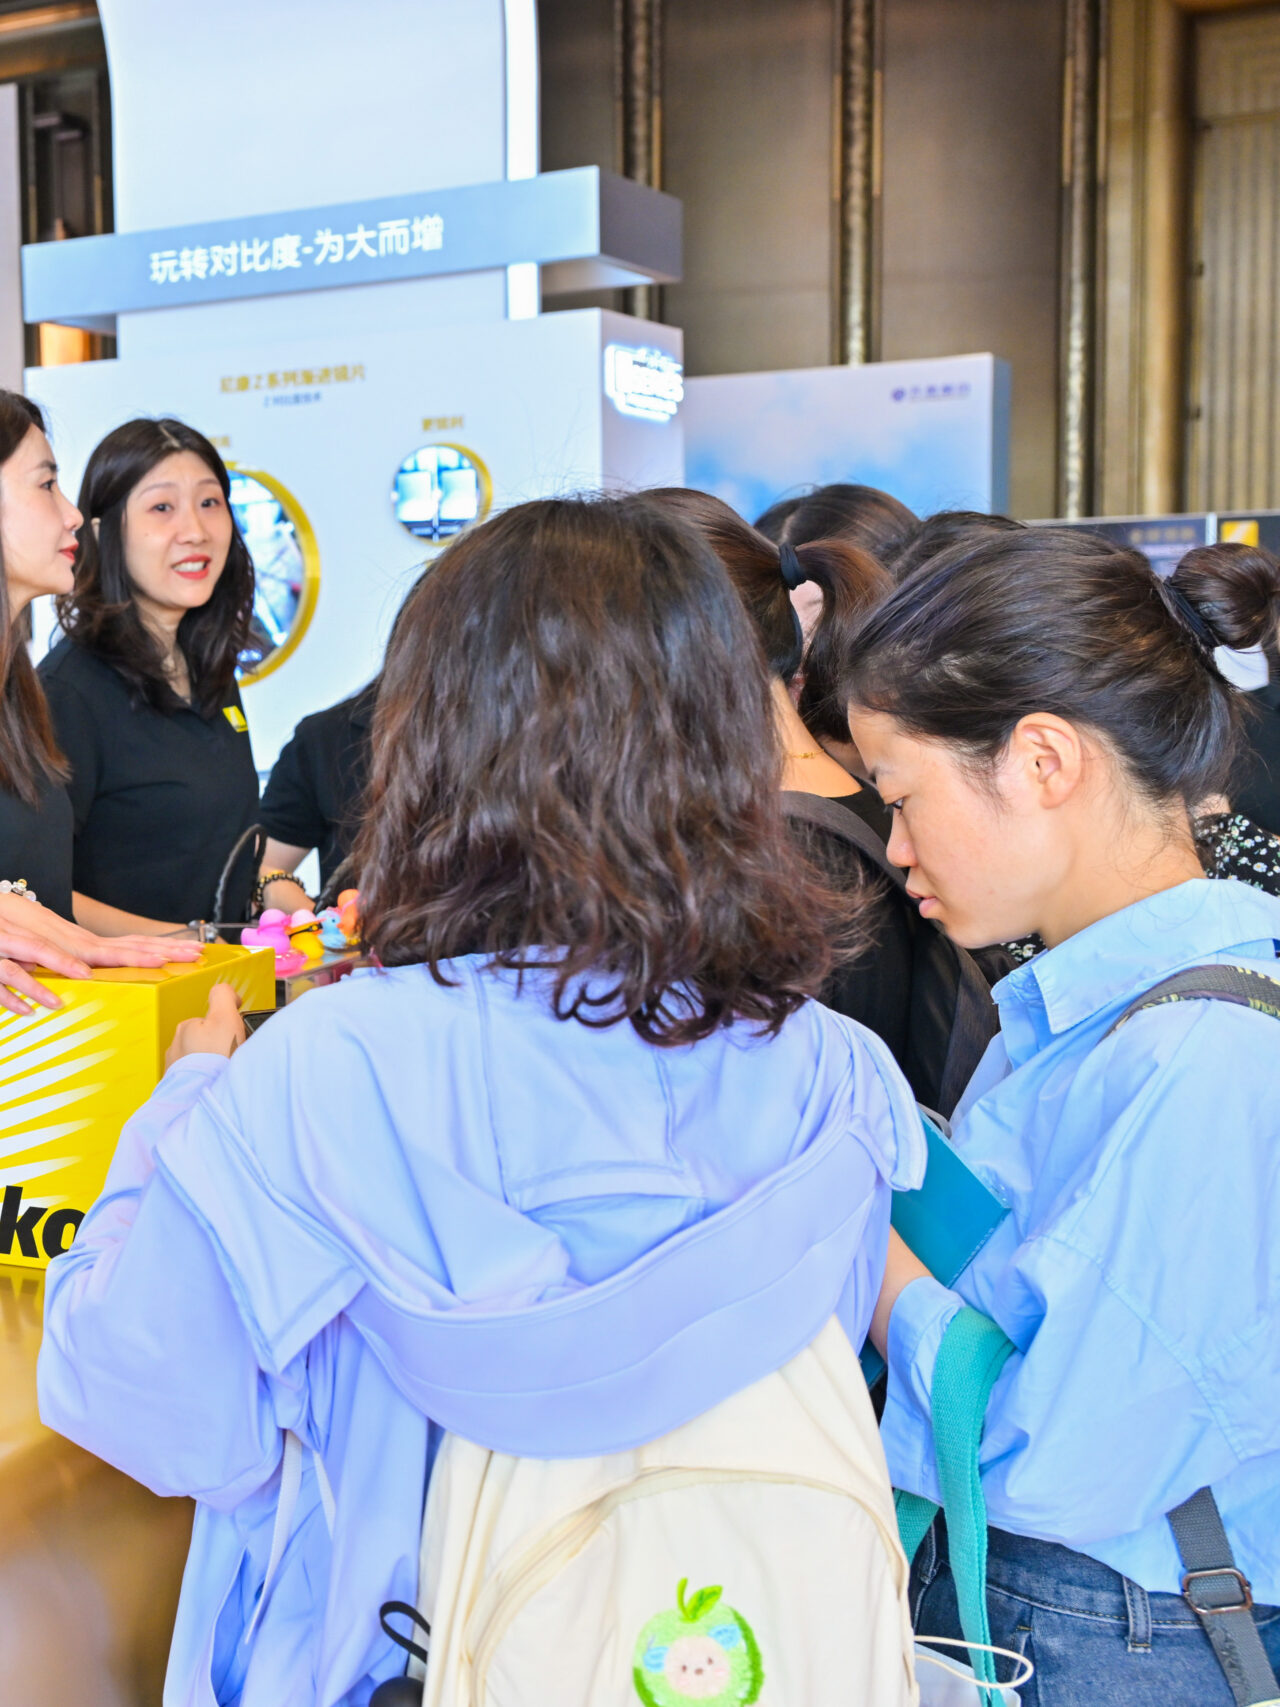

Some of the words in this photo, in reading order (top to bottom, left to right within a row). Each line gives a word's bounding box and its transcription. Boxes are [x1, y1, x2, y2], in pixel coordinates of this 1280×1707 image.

[149, 213, 445, 284] 玩转对比度-为大而增
